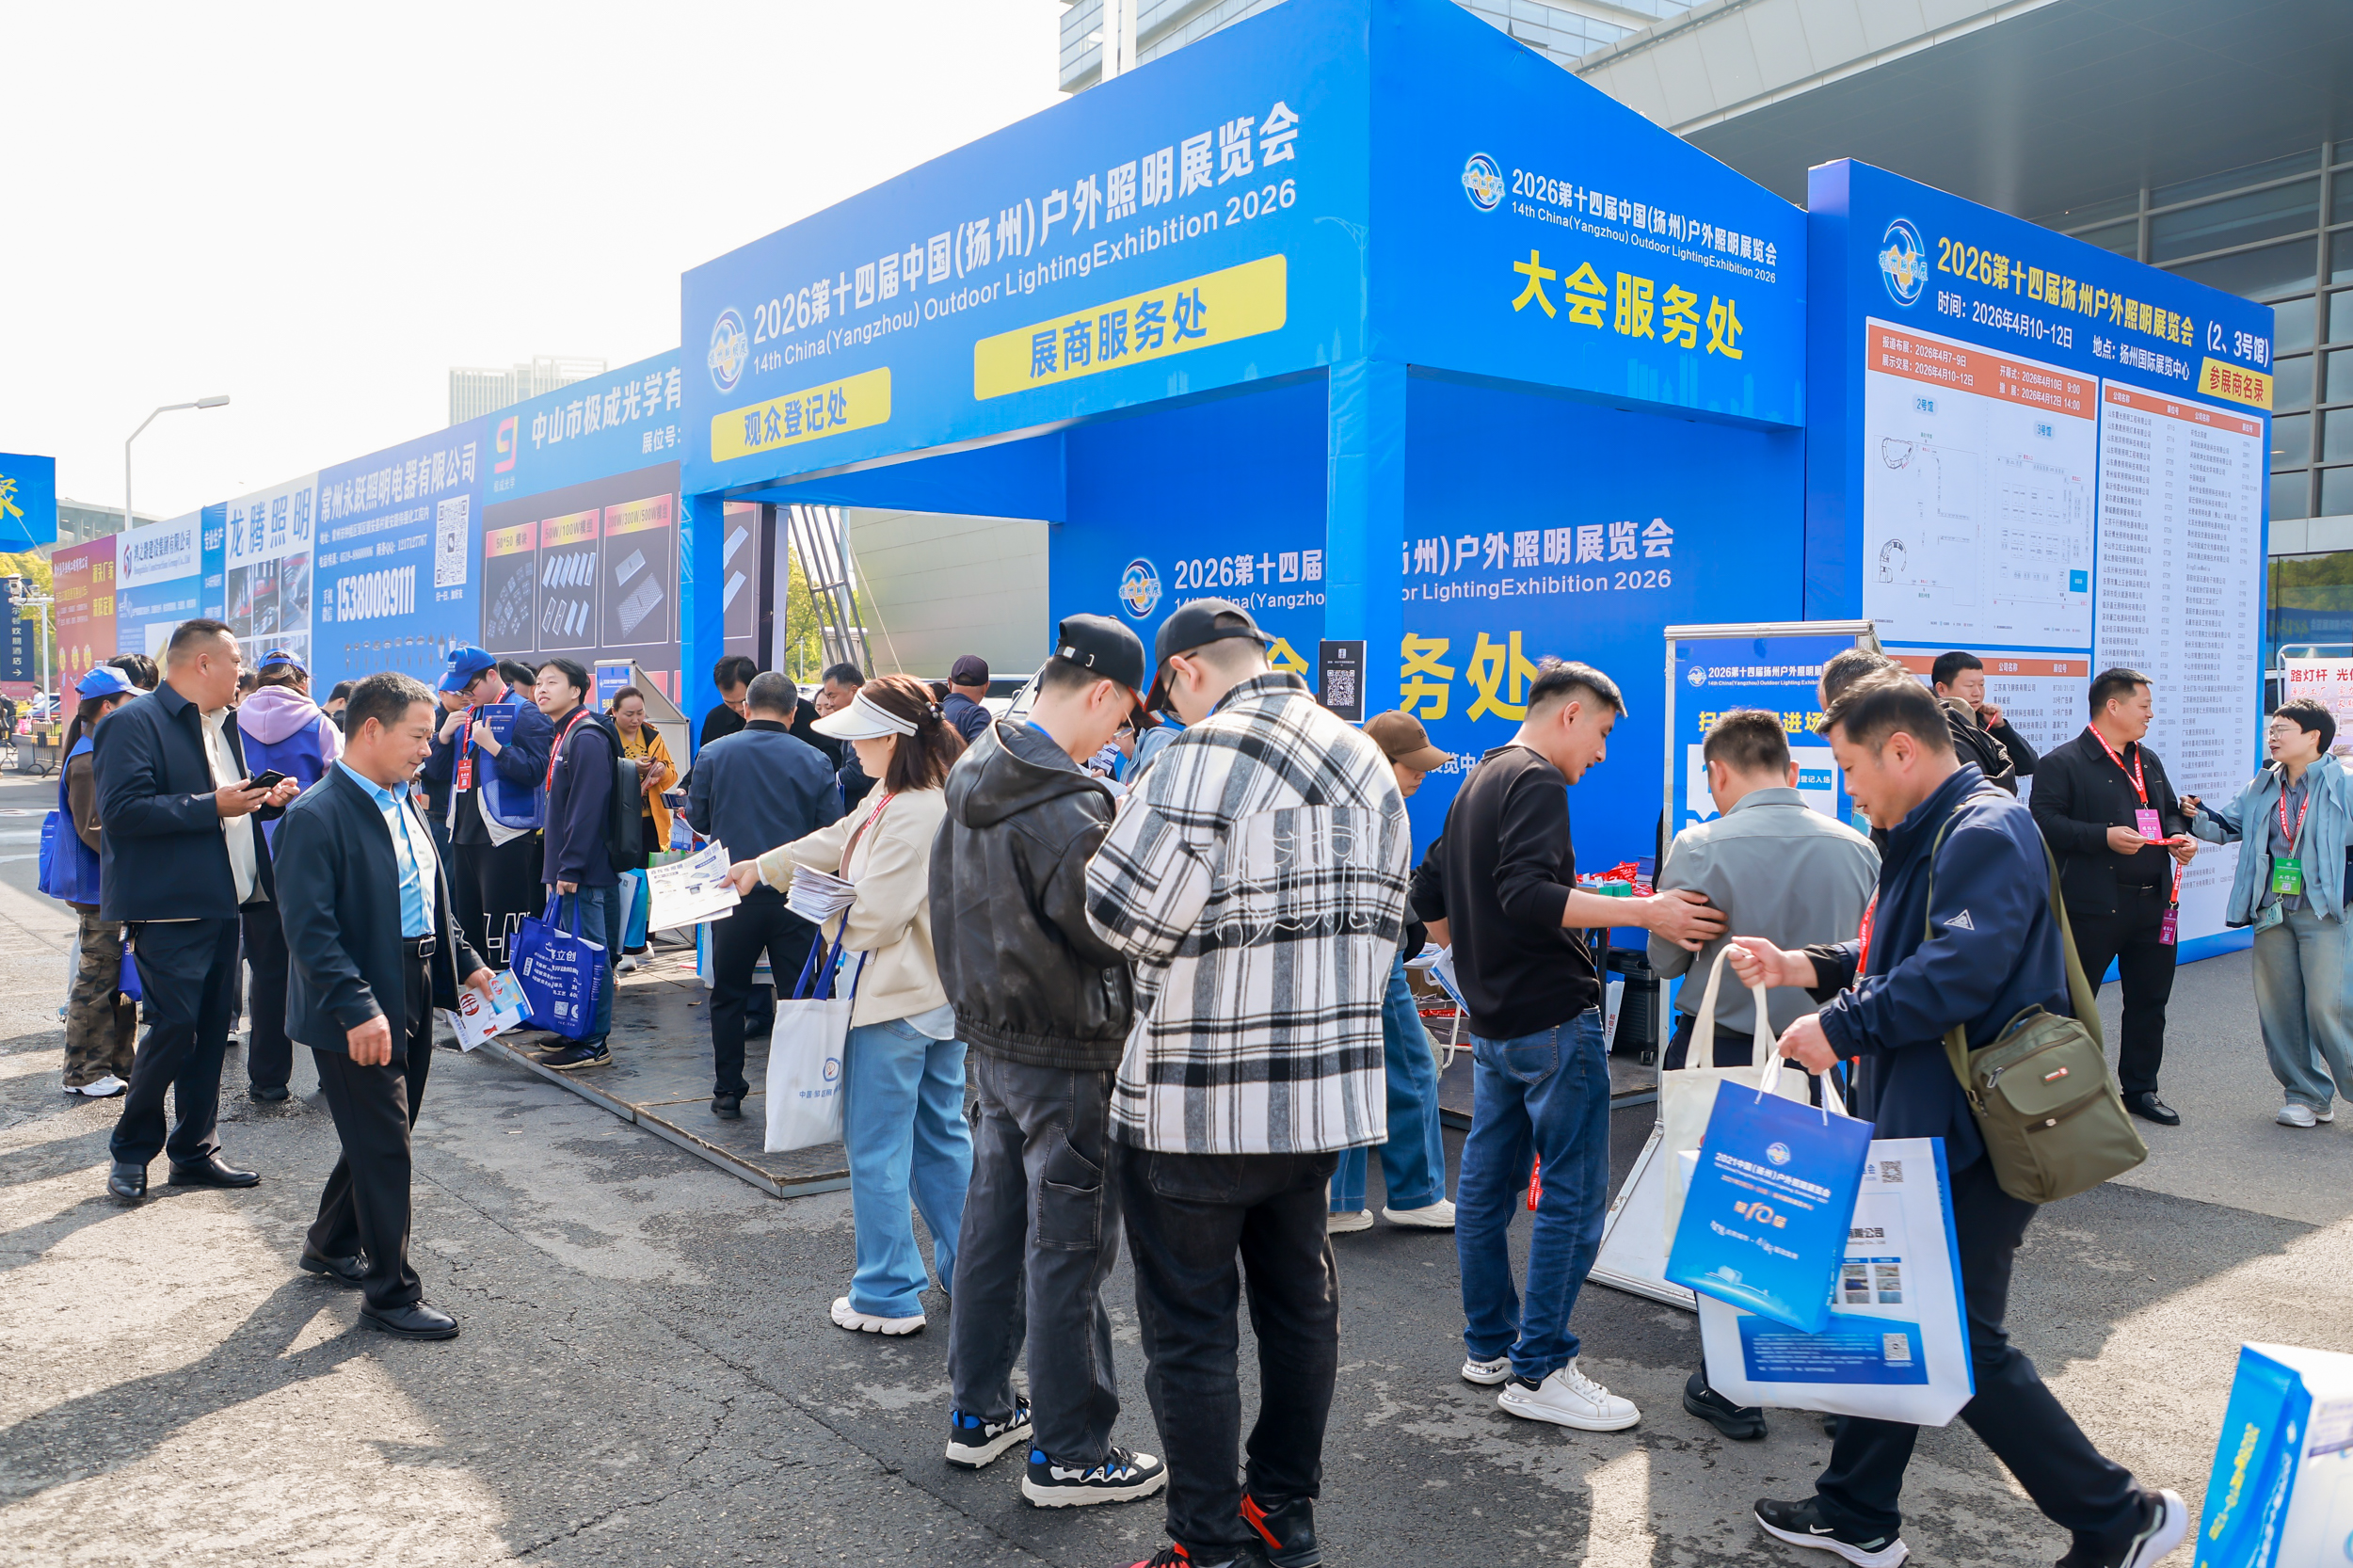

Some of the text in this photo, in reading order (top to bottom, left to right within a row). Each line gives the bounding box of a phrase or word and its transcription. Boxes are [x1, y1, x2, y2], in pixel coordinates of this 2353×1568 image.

[754, 101, 1299, 344] 2026第十四届中国(扬州)户外照明展览会
[1512, 201, 1776, 284] 14th China(Yangzhou) Outdoor LightingExhibition 2026
[1513, 168, 1778, 266] 2026第十四届中国(扬州)户外照明展览会
[754, 178, 1296, 375] 14th China(Yangzhou) Outdoor LightingExhibition 2026
[1512, 248, 1743, 360] 大会服务处
[1937, 236, 2194, 348] 2026第十四届扬州户外照明展览会
[1029, 288, 1208, 380] 展商服务处
[744, 387, 848, 447] 观众登记处
[2067, 382, 2081, 395] 9:00
[2209, 366, 2265, 402] 参展商名录
[229, 487, 312, 559] 龙腾照明
[337, 564, 416, 623] 15380089111
[1175, 549, 1322, 589] 2026第十四届
[1422, 574, 1609, 602] LightingExhibition
[1614, 568, 1673, 590] 2026
[2290, 668, 2329, 682] 路灯杆
